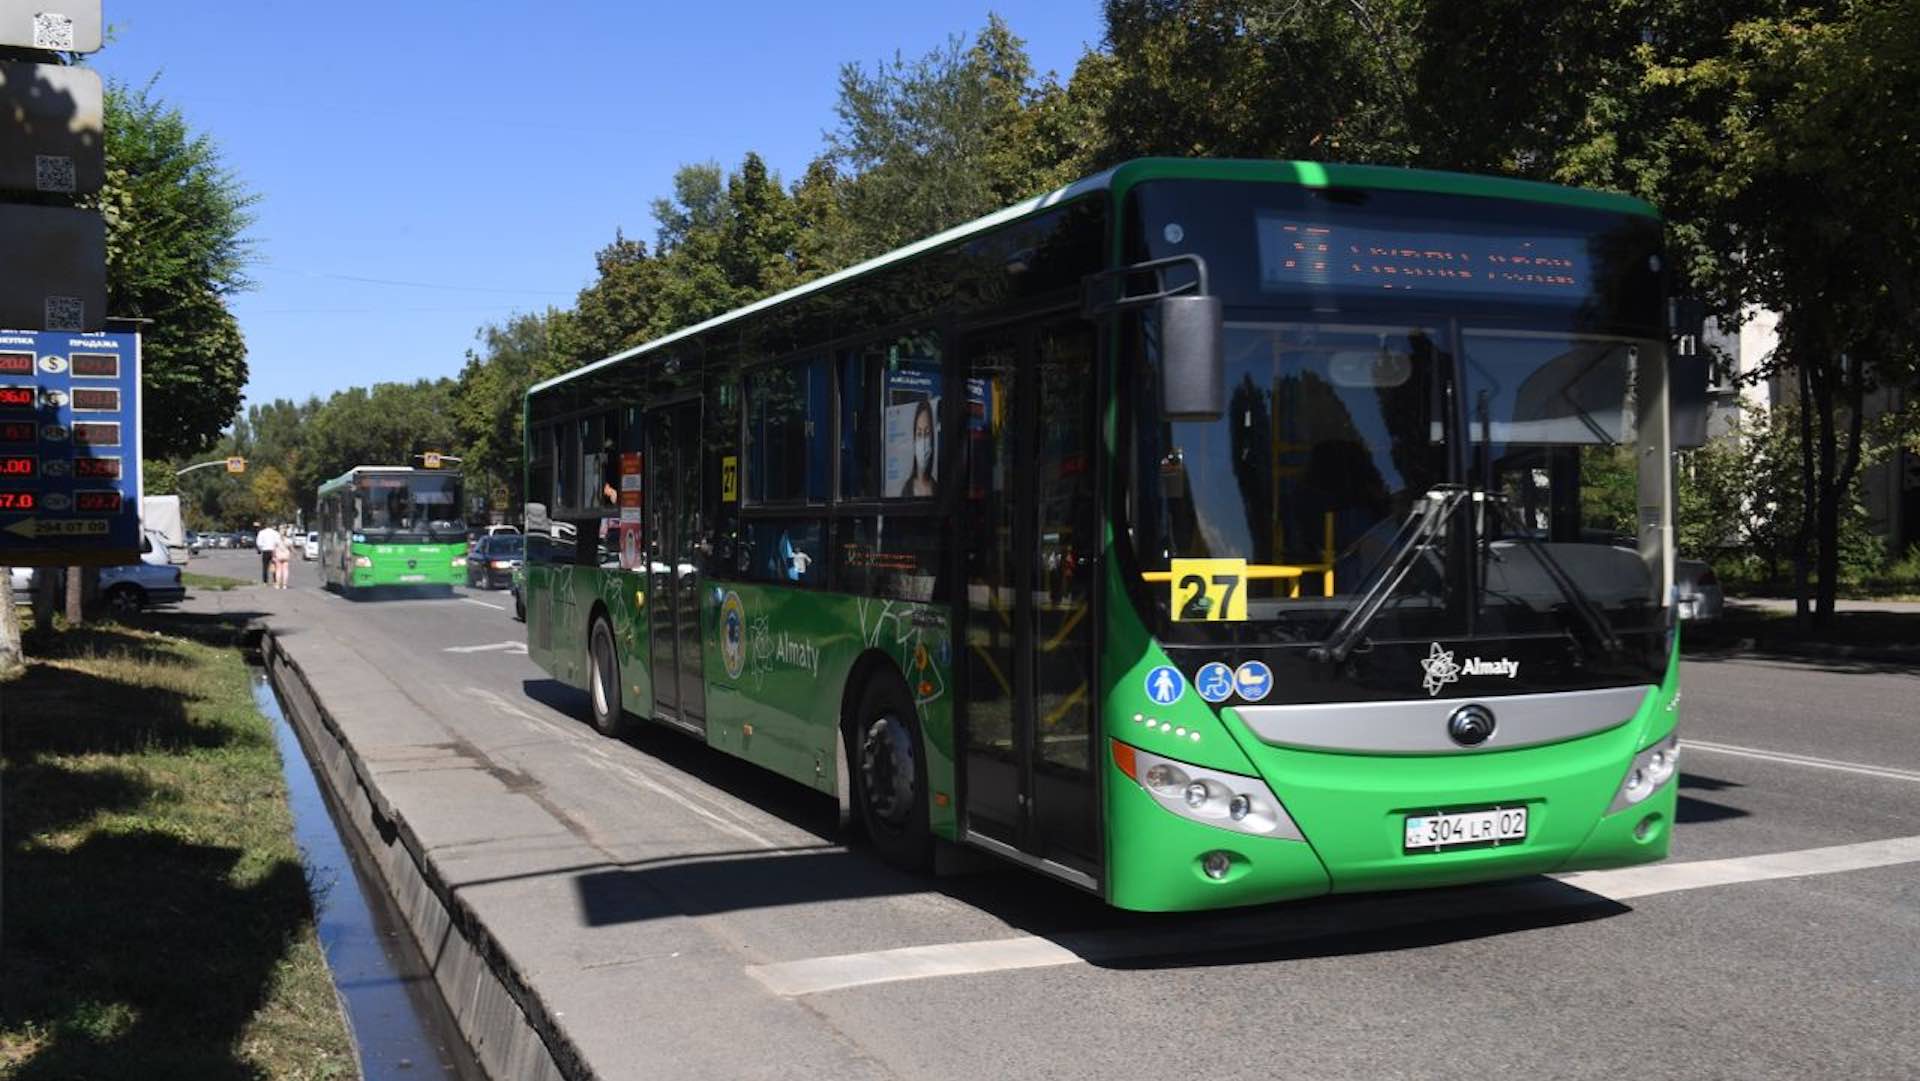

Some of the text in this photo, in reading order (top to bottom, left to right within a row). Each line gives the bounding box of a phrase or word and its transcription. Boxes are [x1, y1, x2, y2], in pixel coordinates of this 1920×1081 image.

[724, 466, 735, 493] 27
[1178, 574, 1240, 619] 27
[776, 631, 820, 678] Almaty
[1461, 656, 1520, 679] Almaty
[1428, 818, 1464, 842] 304
[1470, 820, 1493, 838] LR
[1500, 812, 1524, 834] 02
